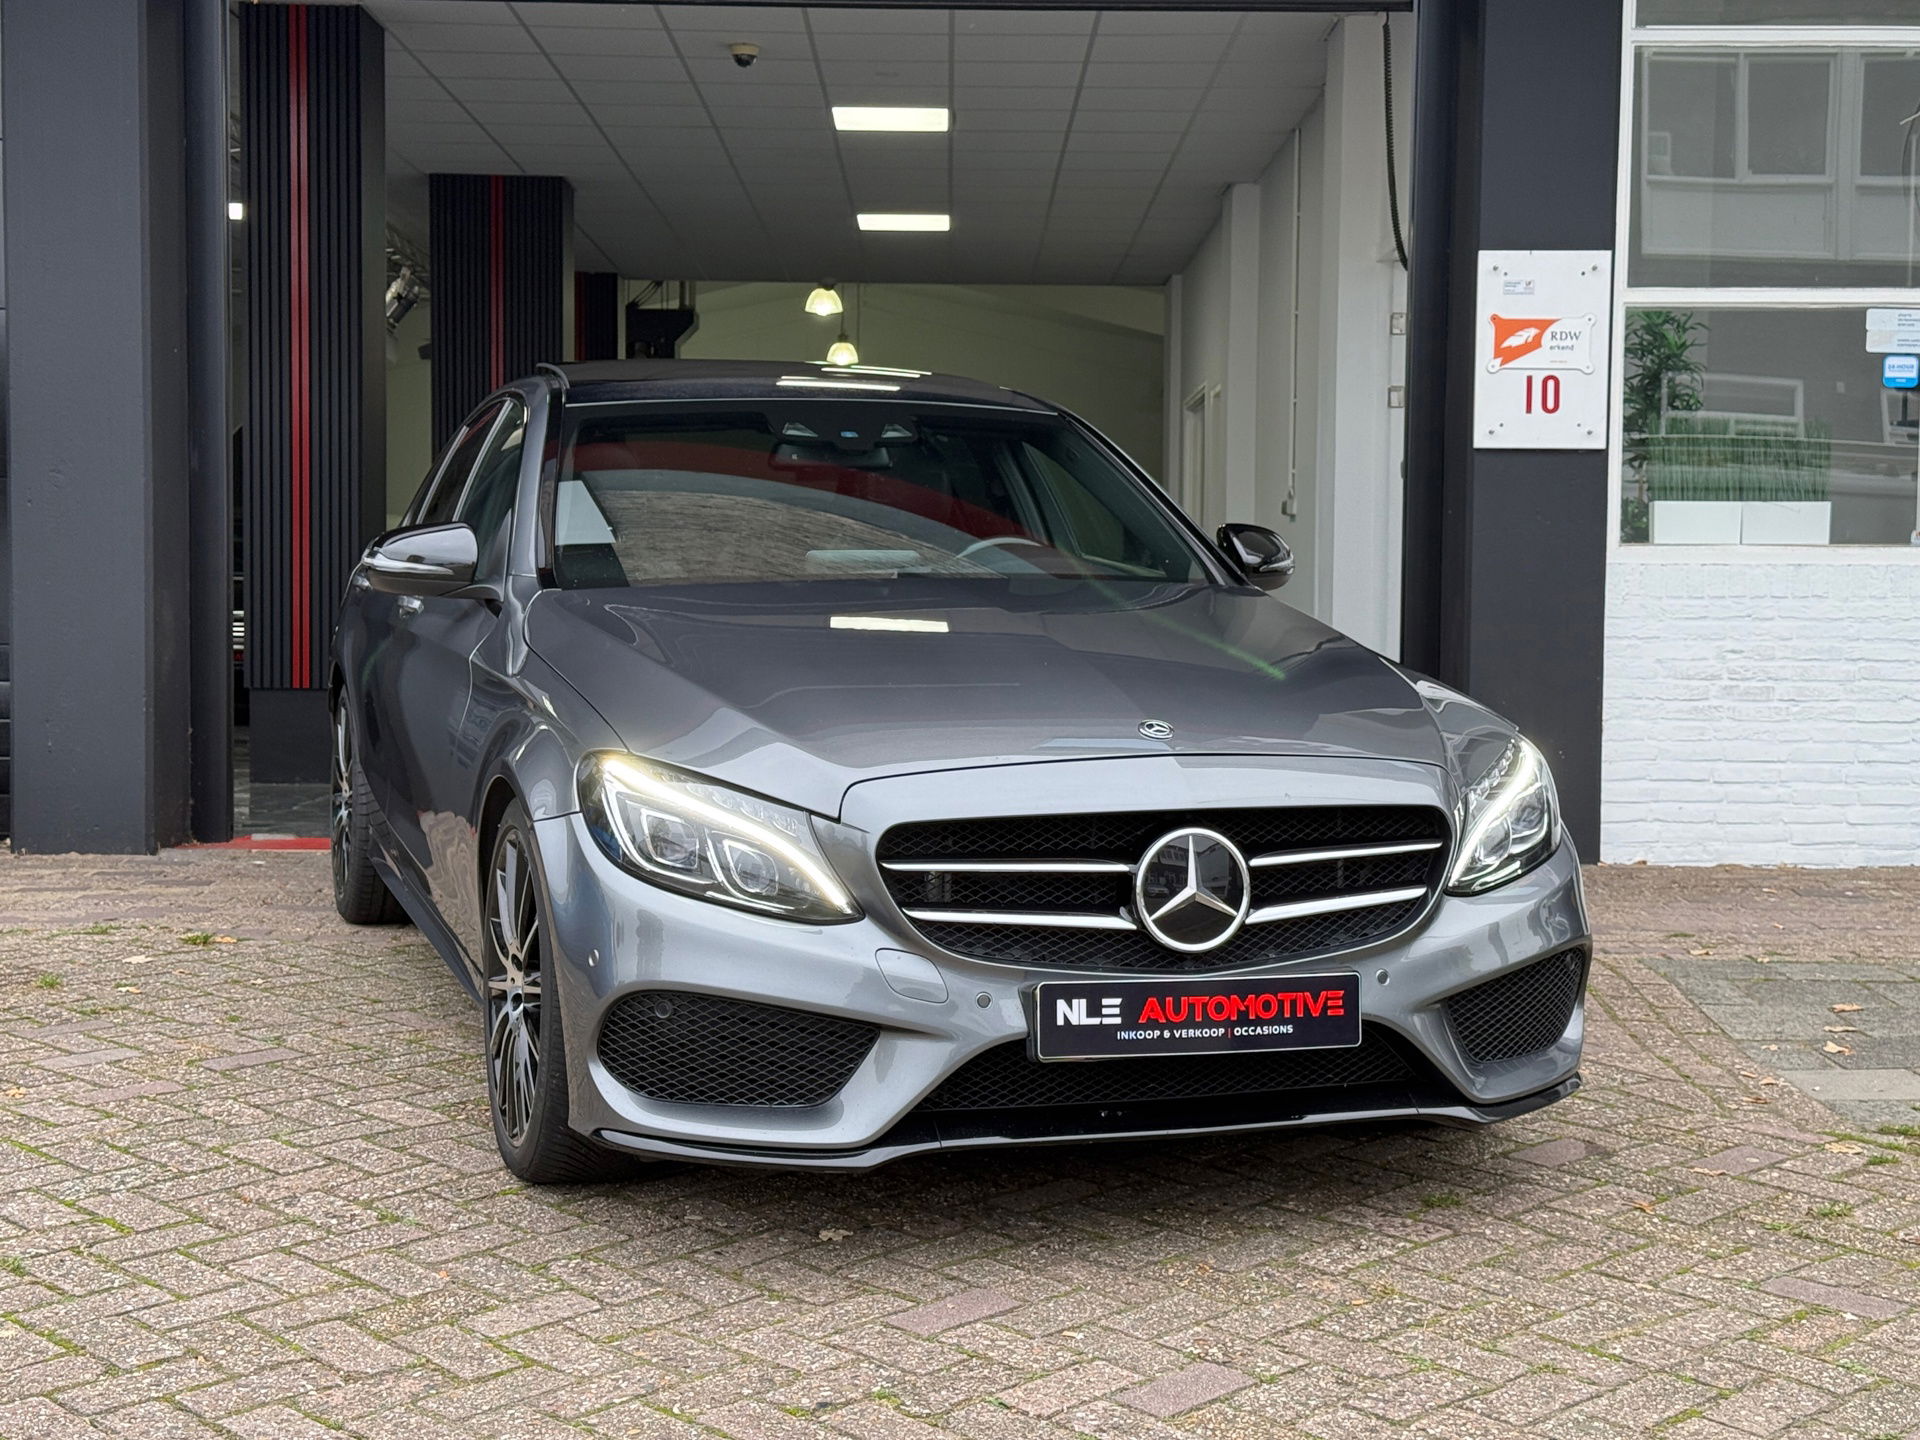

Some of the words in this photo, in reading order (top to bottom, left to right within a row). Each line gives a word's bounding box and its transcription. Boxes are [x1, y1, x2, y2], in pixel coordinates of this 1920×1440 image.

[1550, 330, 1582, 341] RDW
[1525, 375, 1560, 414] 10
[1056, 998, 1122, 1026] NLE
[1138, 990, 1345, 1023] AUTOMOTIVE
[1117, 1029, 1160, 1040] INKOOP
[1163, 1028, 1171, 1039] &
[1173, 1027, 1226, 1039] VERKOOP
[1233, 1024, 1294, 1036] OCCASIONS
